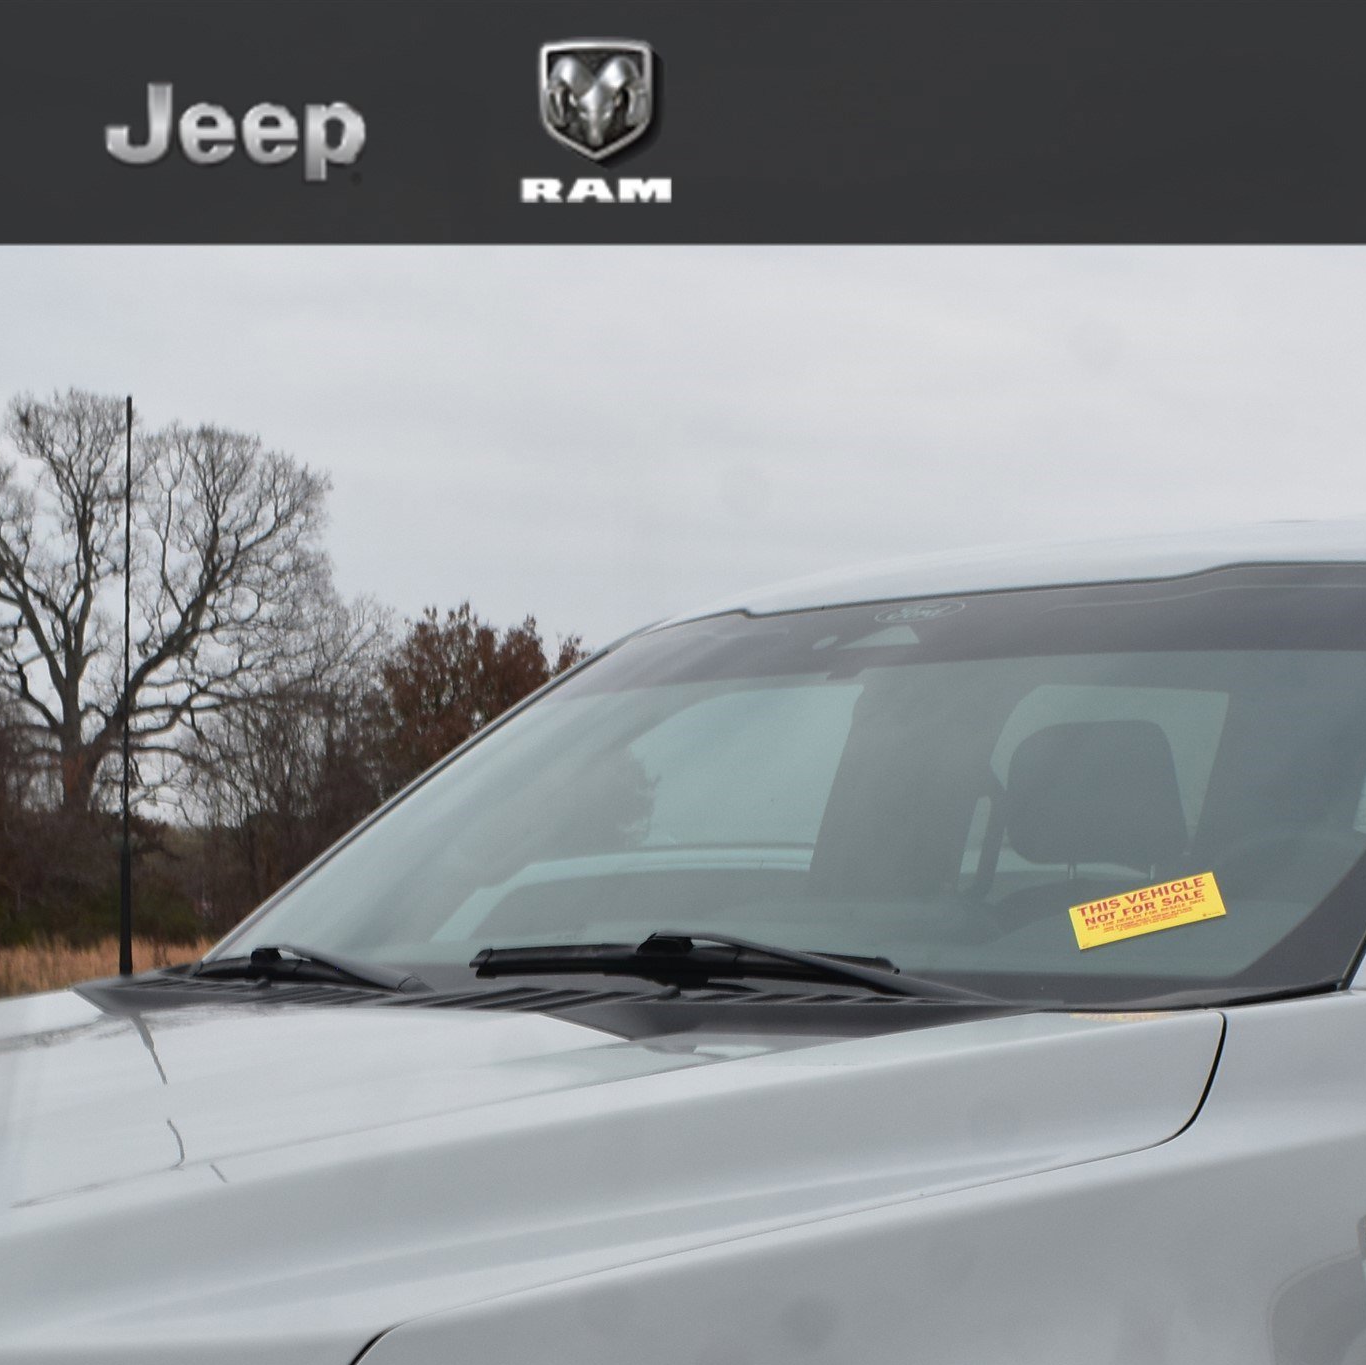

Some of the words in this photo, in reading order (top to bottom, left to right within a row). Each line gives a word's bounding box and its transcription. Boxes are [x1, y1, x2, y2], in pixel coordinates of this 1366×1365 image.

[1077, 898, 1121, 917] THIS
[1124, 877, 1206, 904] VEHICLE
[1084, 912, 1117, 926] NOT
[1123, 901, 1155, 917] FOR
[1161, 889, 1205, 906] SALE
